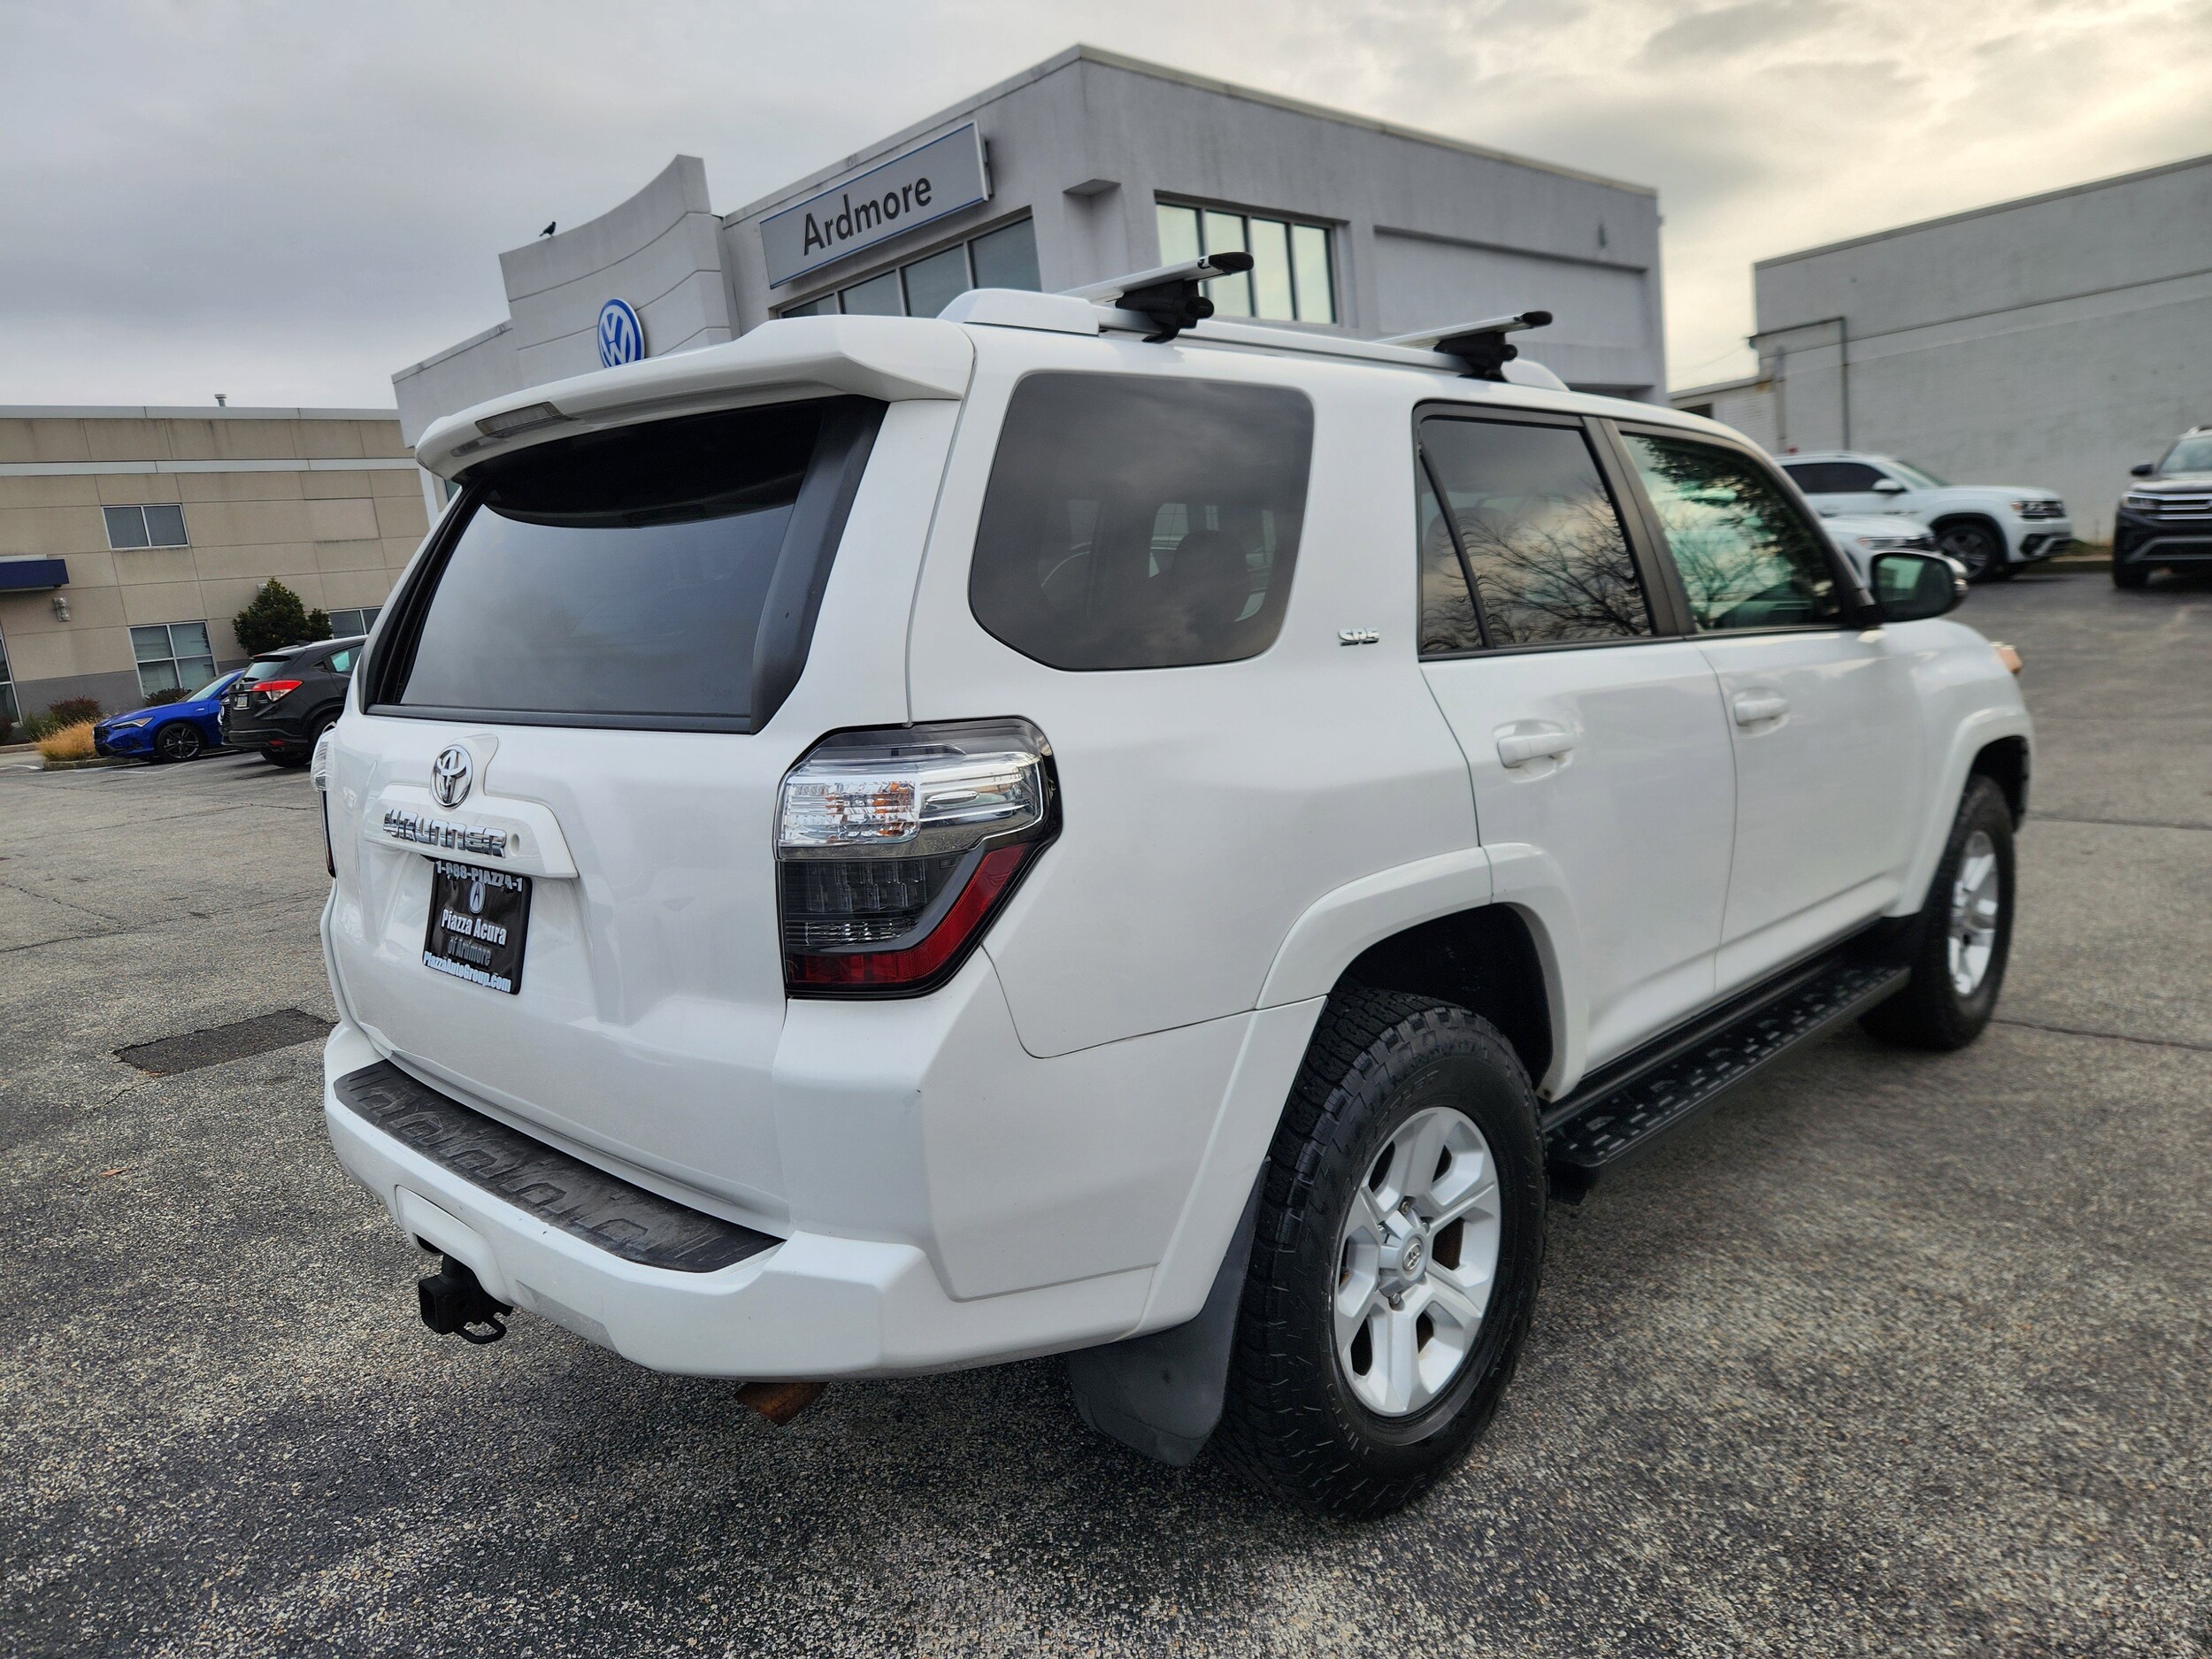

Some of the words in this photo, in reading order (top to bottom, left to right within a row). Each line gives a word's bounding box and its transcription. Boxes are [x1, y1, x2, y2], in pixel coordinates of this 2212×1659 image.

[803, 177, 932, 256] Ardmore
[441, 908, 472, 936] Piazza
[472, 918, 507, 946] Acura
